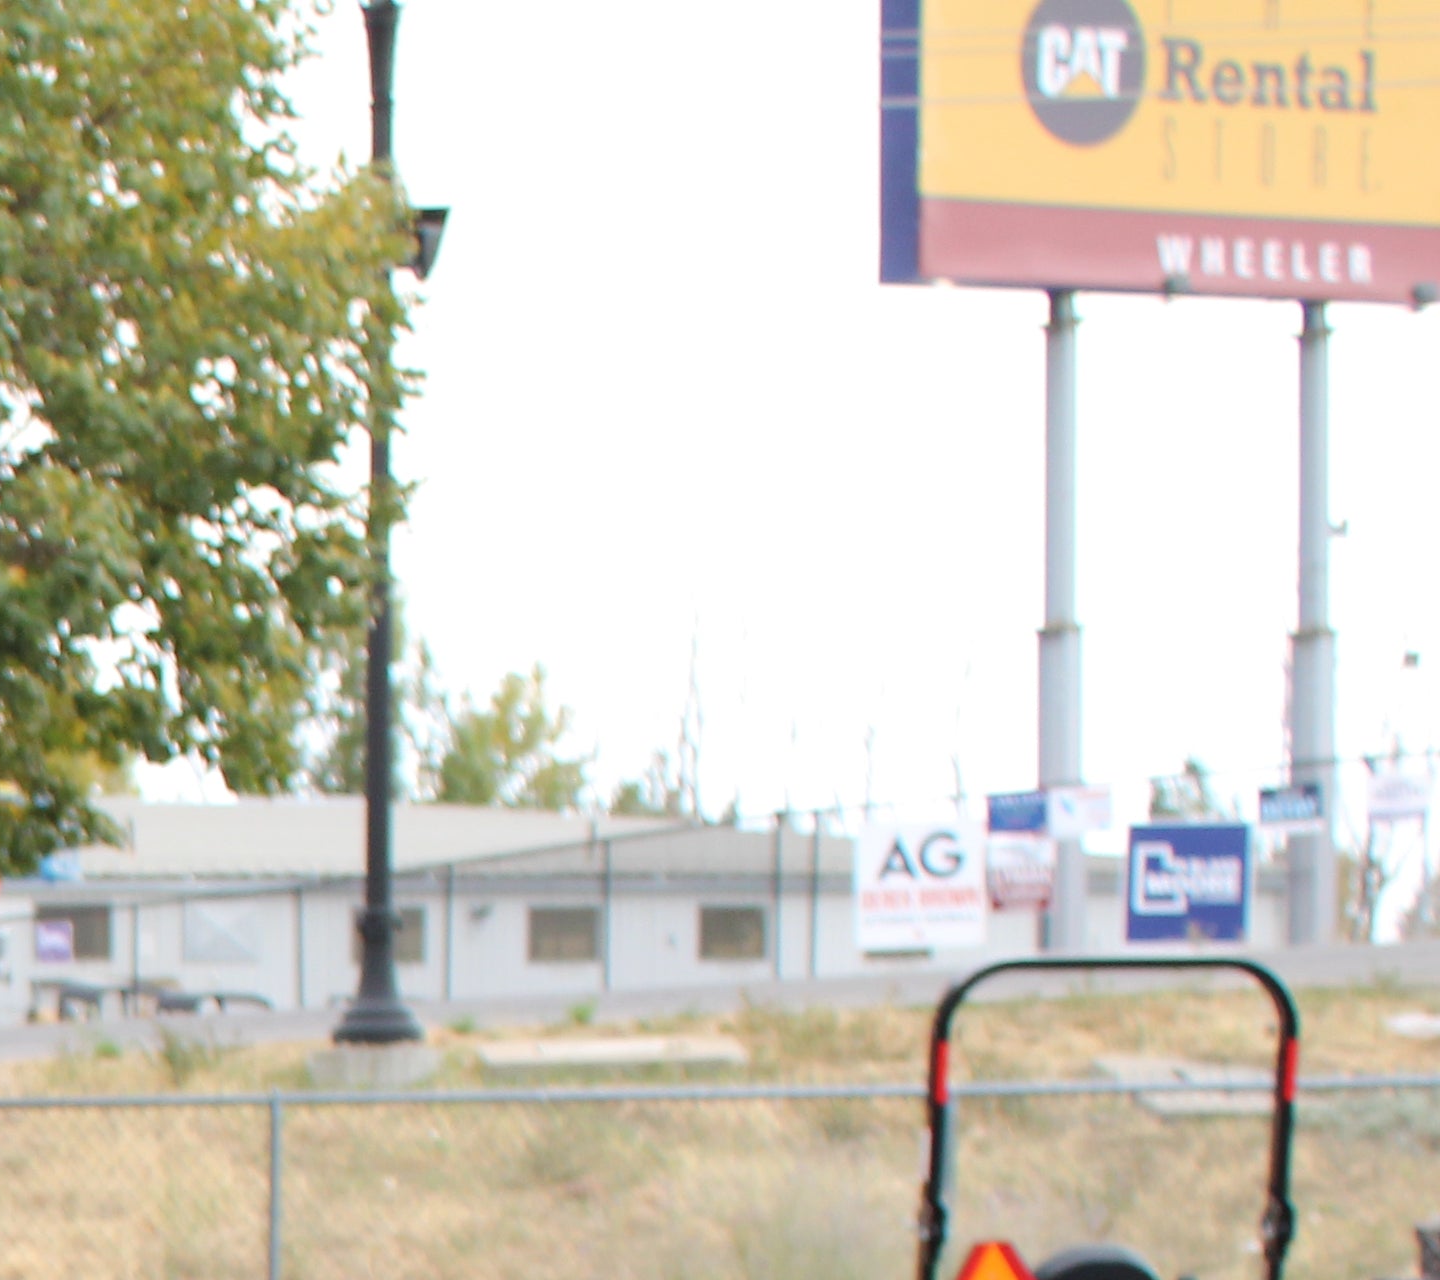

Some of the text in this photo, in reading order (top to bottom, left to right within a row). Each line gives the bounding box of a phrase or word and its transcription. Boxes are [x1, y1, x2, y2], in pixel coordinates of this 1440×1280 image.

[1036, 25, 1128, 98] CAT
[1158, 36, 1378, 114] Rental
[1157, 234, 1372, 283] WHEELER
[879, 830, 964, 879] AG
